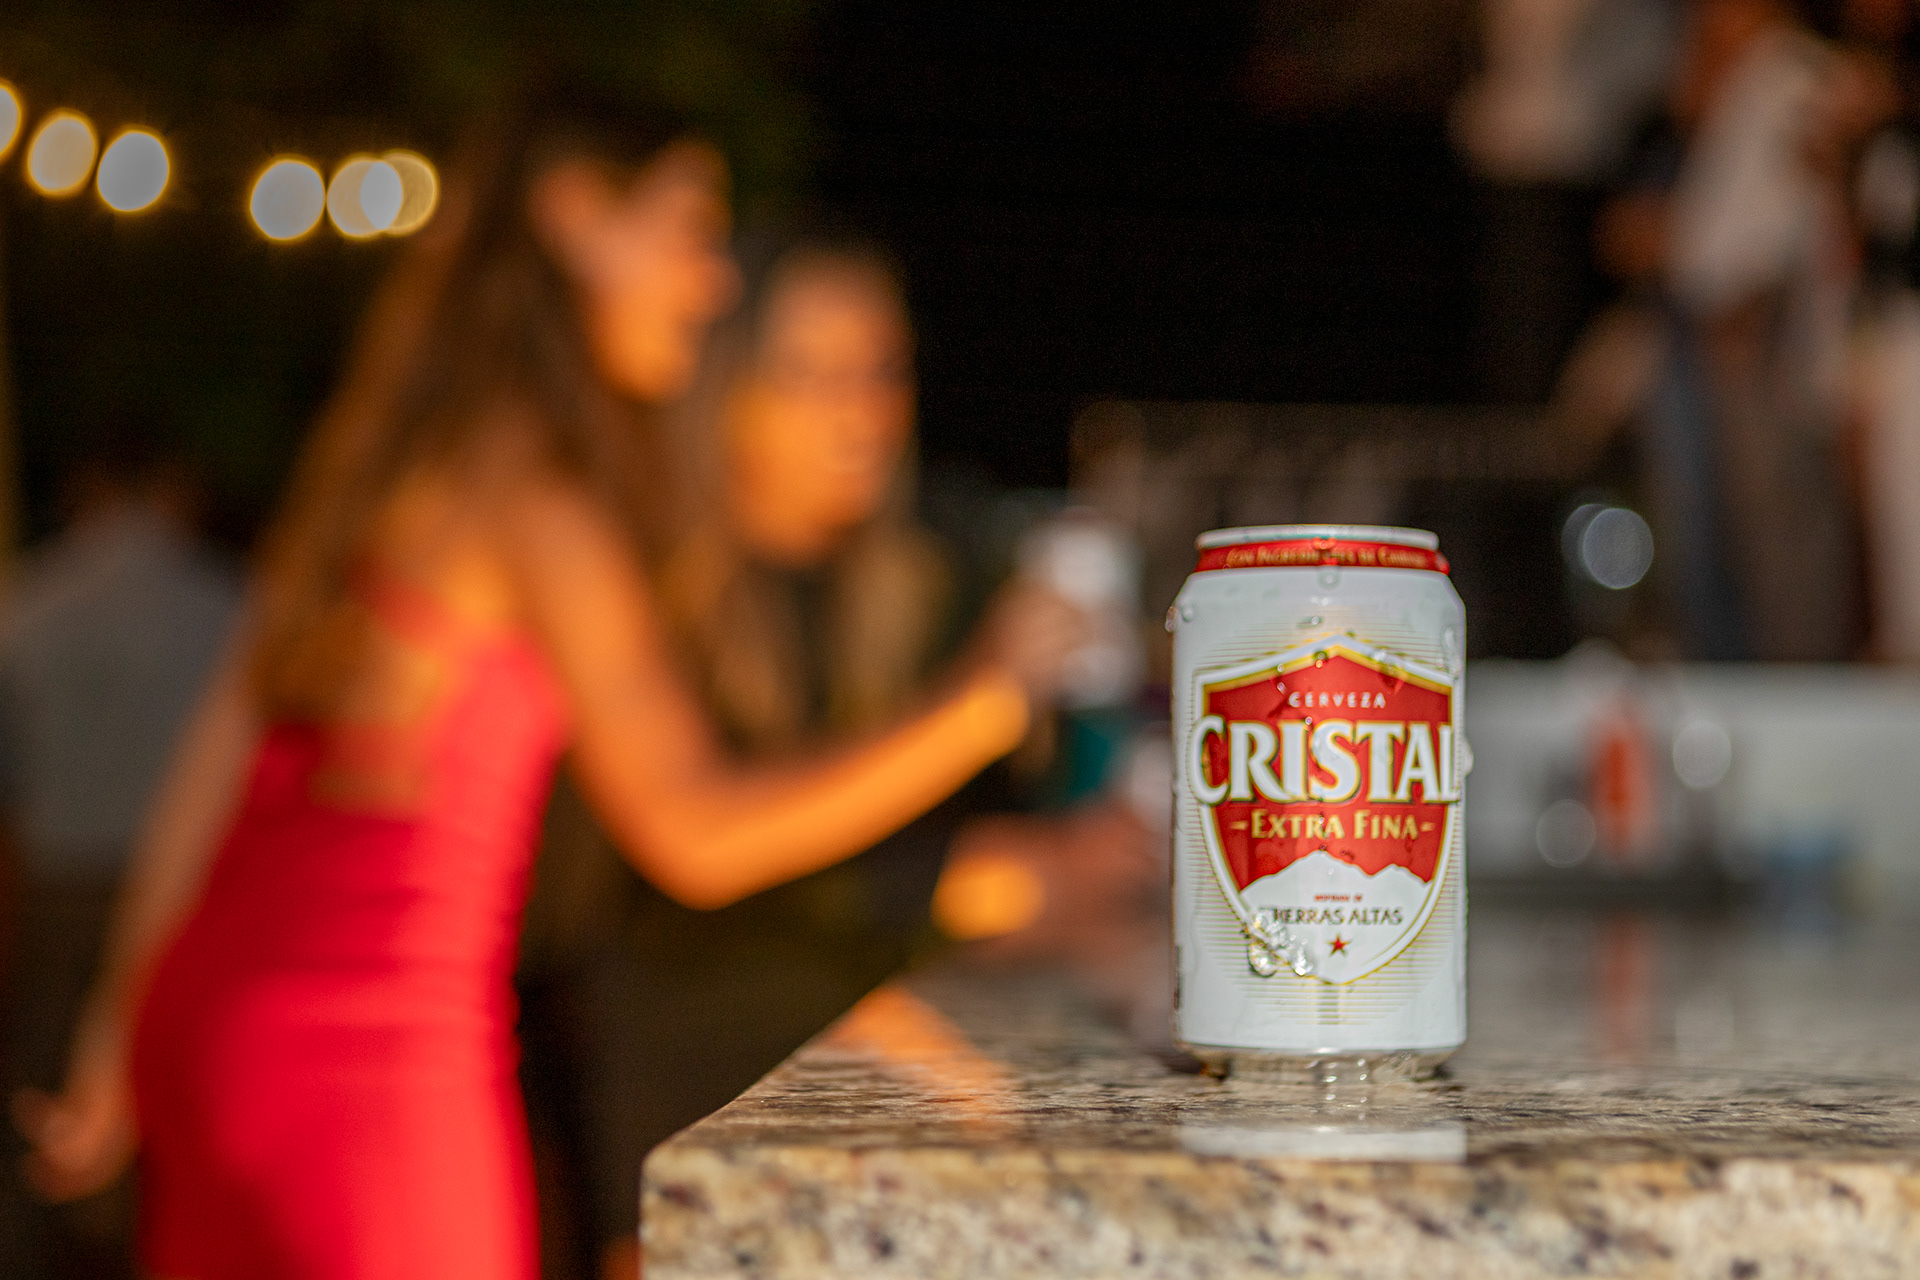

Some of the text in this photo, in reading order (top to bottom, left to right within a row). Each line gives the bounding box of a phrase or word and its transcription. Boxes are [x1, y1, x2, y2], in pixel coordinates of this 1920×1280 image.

[1288, 691, 1386, 709] CERVEZA
[1187, 714, 1461, 806] CRISTAL
[1251, 808, 1419, 840] EXTRA FINA
[1347, 907, 1403, 926] ALTAS
